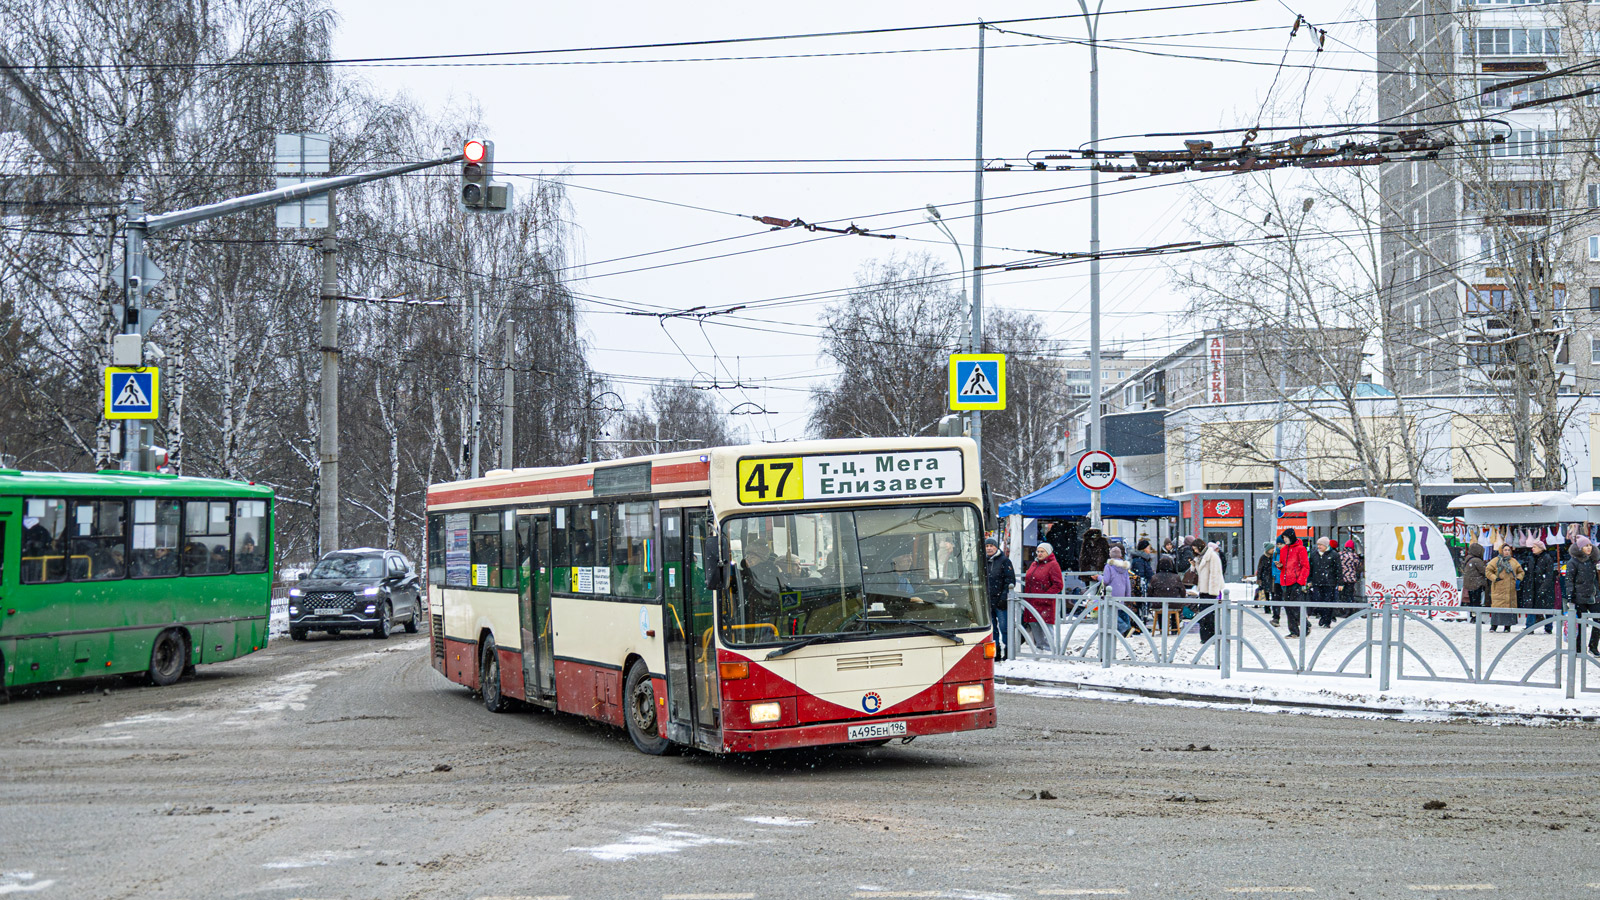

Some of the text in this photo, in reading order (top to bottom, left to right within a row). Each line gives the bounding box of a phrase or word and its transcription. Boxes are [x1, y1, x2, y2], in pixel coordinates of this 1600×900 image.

[1210, 338, 1222, 403] АПТЕКА
[818, 455, 939, 477] т.ц. Мега
[744, 462, 794, 499] 47
[820, 476, 946, 495] Елизавет
[1391, 563, 1434, 572] ЕКАТЕРИНБУРГ
[851, 722, 905, 739] А495ЕН 196
